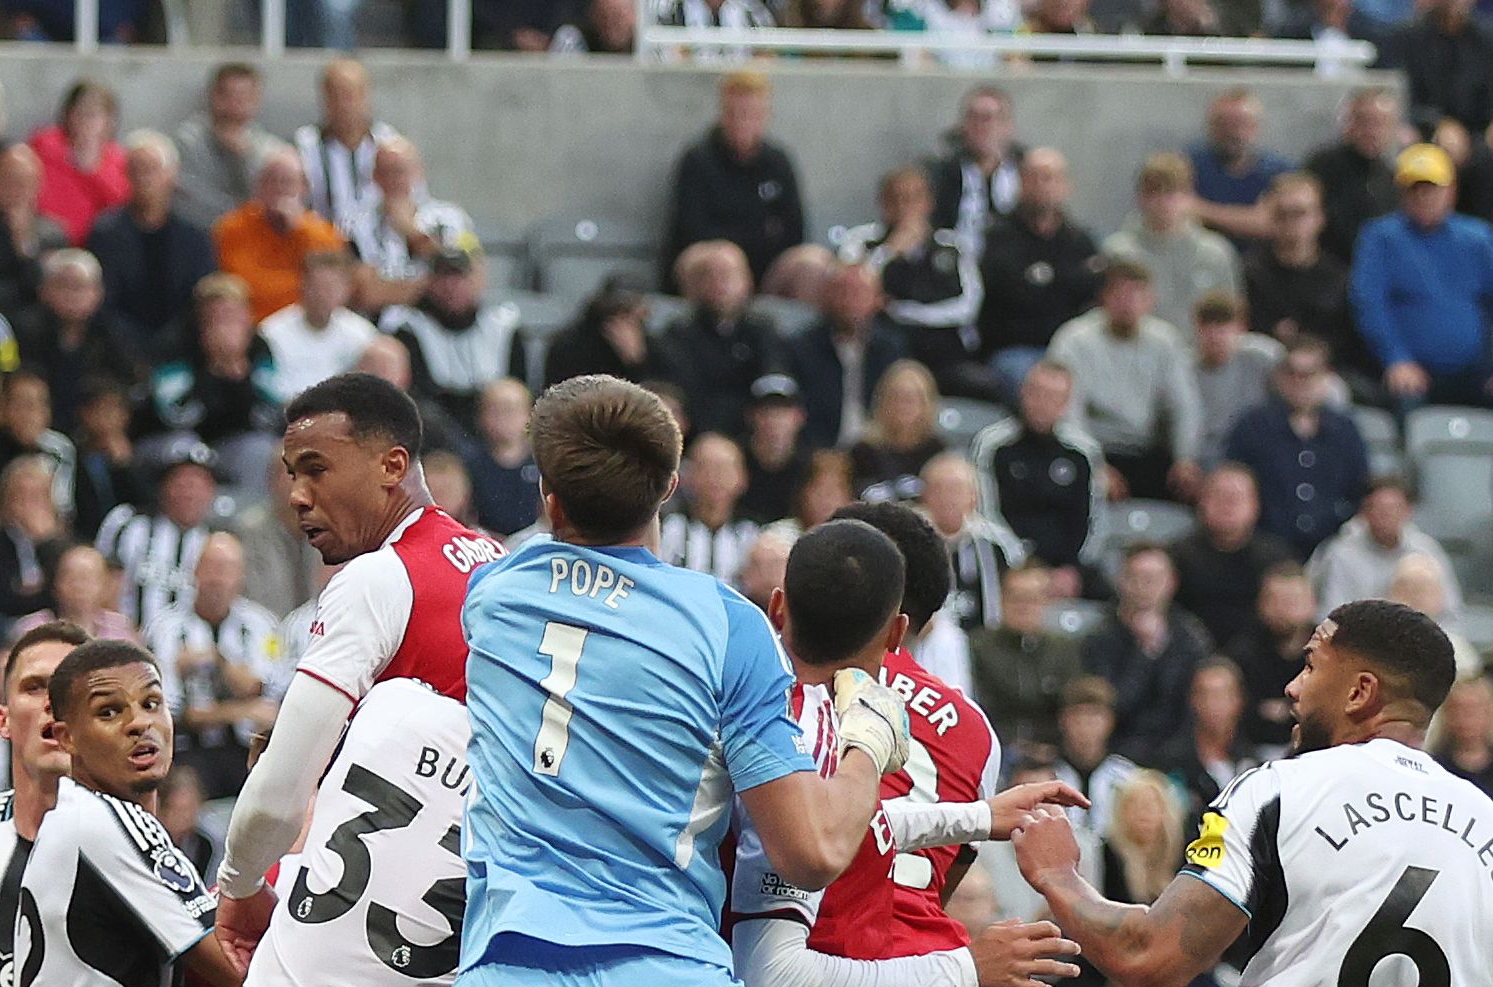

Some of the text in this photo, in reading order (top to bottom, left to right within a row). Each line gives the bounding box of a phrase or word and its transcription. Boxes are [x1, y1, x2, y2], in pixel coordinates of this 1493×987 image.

[442, 535, 511, 574] GABR
[549, 557, 635, 609] POPE
[532, 620, 590, 778] 1
[877, 665, 960, 737] BER
[414, 745, 472, 798] BU
[287, 762, 468, 979] 33
[1313, 791, 1493, 884] LASCELLE
